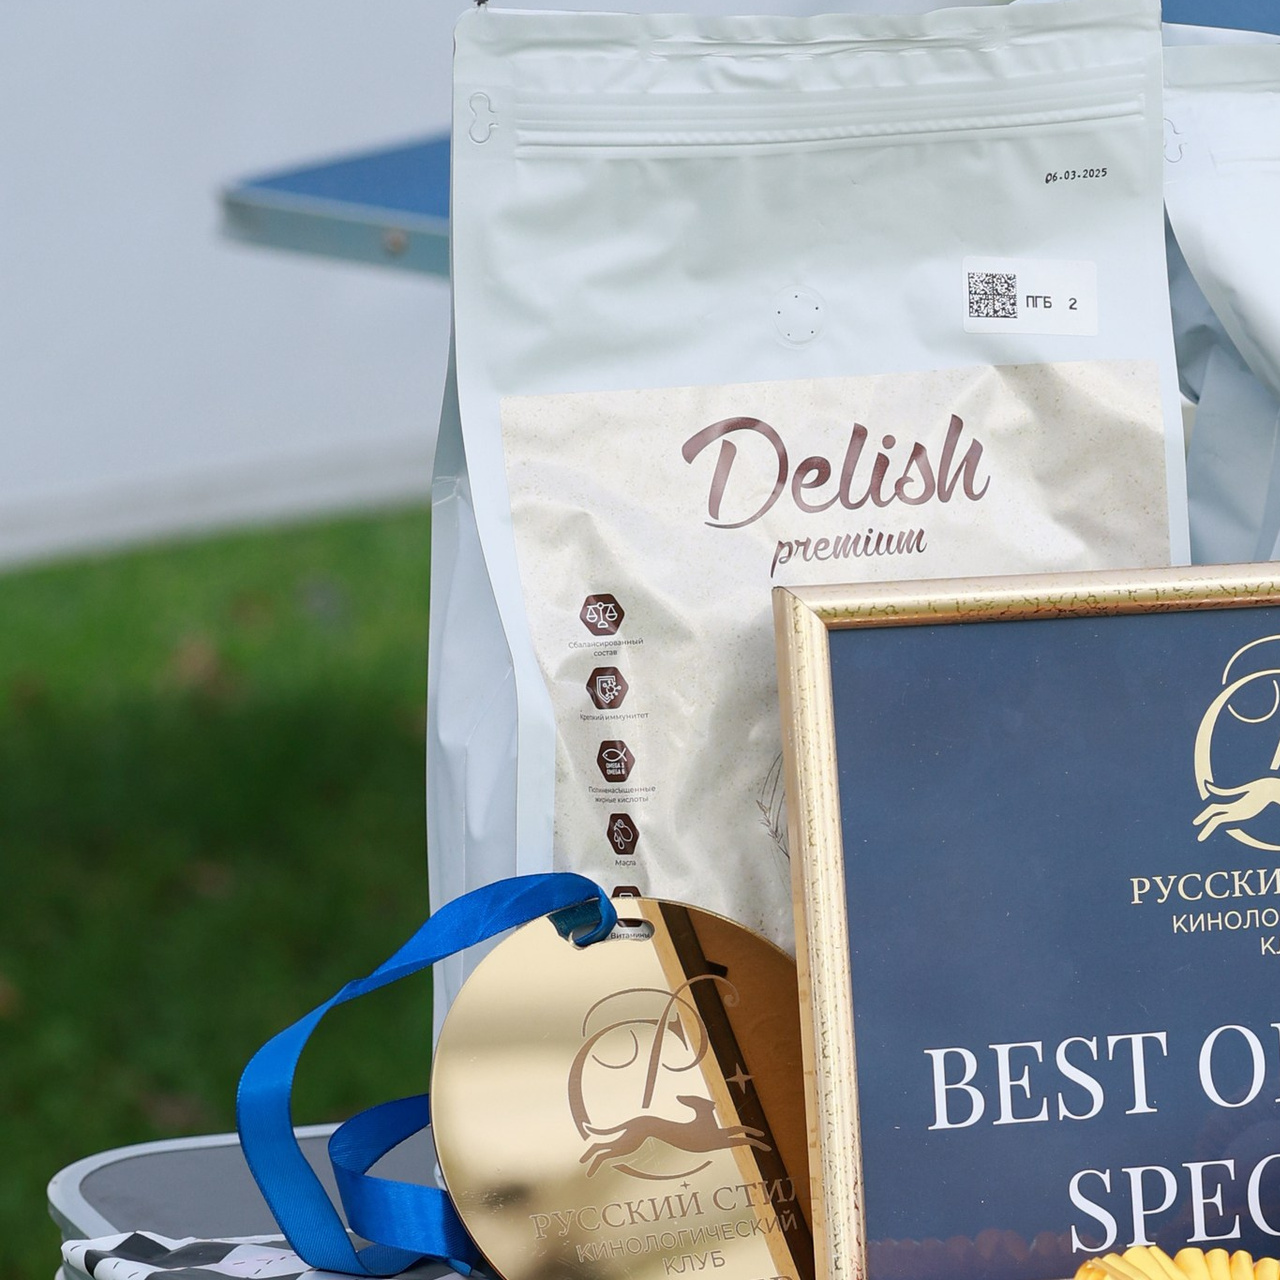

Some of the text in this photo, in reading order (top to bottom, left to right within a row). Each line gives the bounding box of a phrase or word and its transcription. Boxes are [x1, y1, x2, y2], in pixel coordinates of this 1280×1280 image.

[1045, 167, 1108, 184] 06.03.2025
[1026, 295, 1079, 310] ПГБ 2
[681, 414, 990, 529] Delish
[770, 528, 927, 578] premium
[593, 649, 618, 657] состав
[923, 1031, 1168, 1131] BEST
[529, 1181, 704, 1240] РУССКИЙ
[575, 1210, 798, 1263] КИНОЛОГИЧЕСКИЙ
[662, 1250, 726, 1276] КЛУБ
